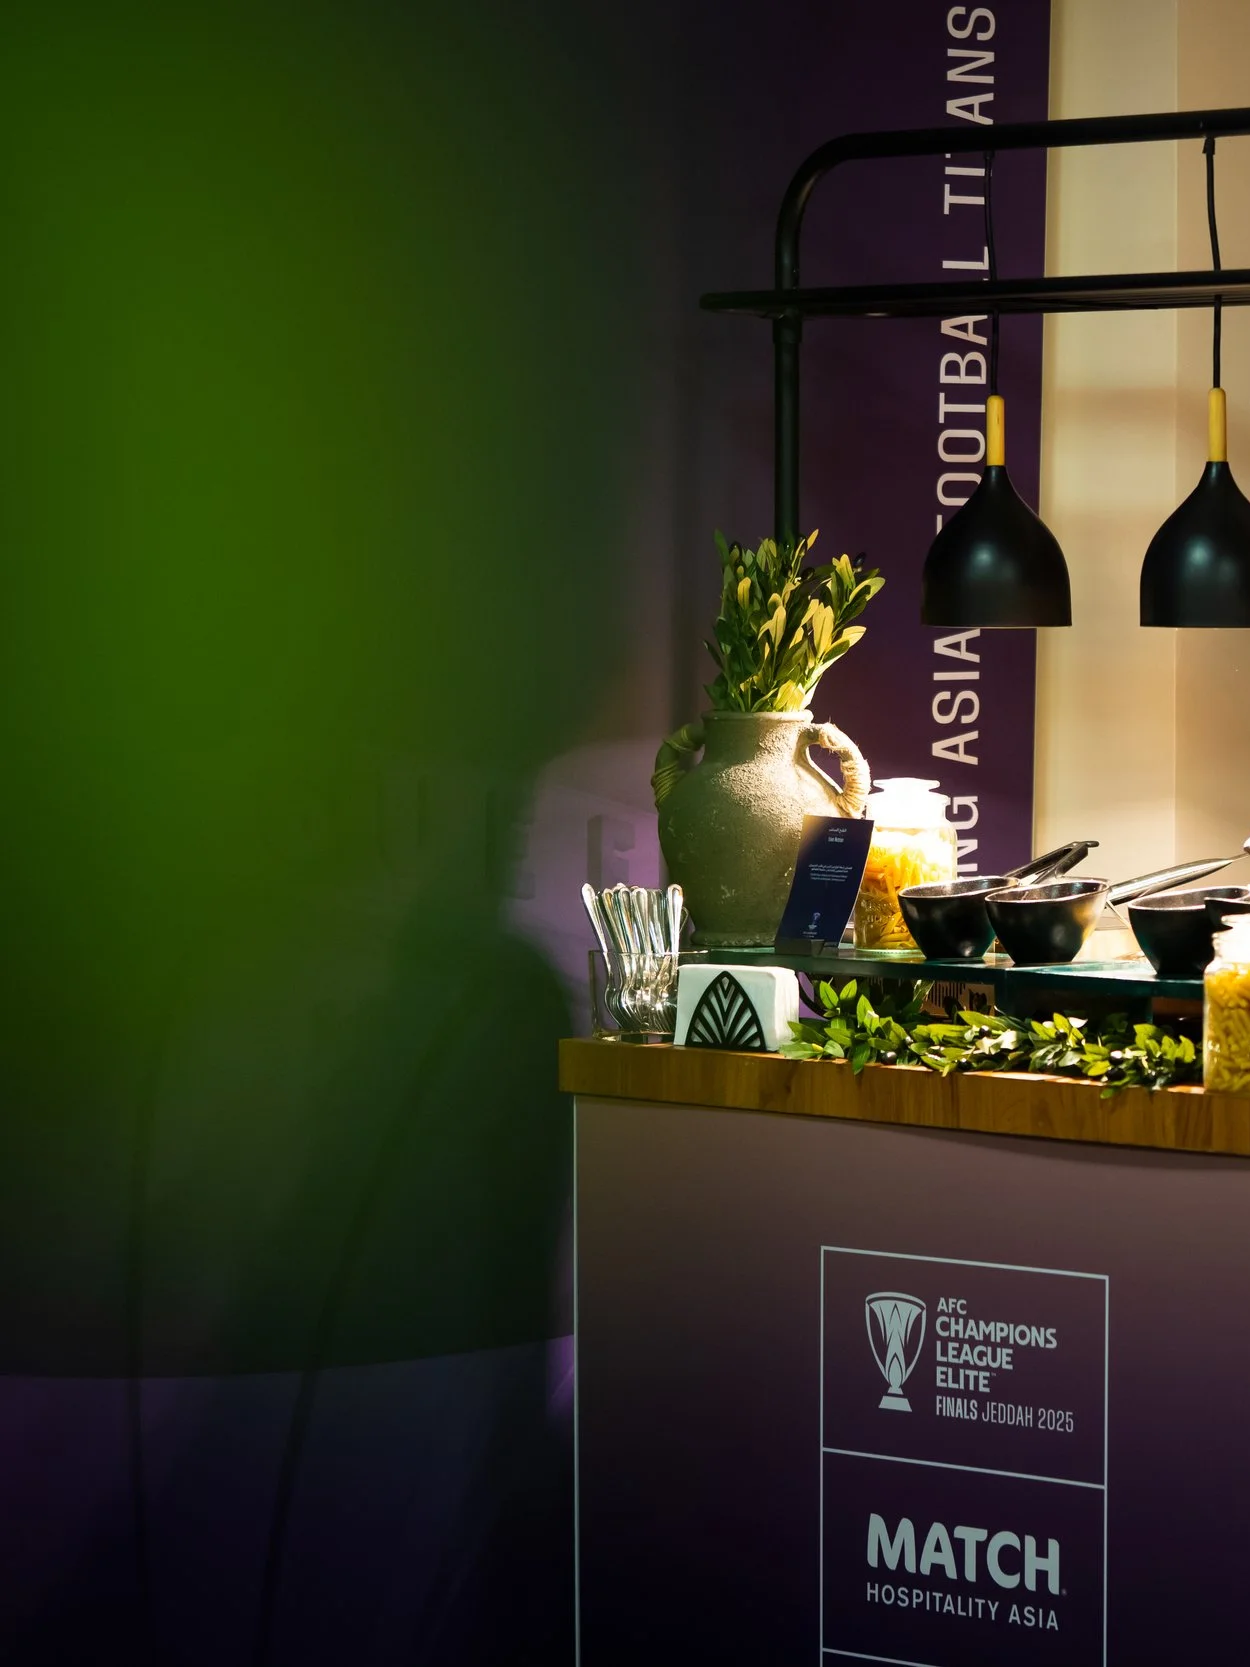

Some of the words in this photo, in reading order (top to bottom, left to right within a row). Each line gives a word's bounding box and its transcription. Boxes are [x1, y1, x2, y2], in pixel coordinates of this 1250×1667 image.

[943, 6, 996, 215] TIANS
[936, 246, 989, 536] OOTBAL
[931, 628, 981, 766] ASIA
[936, 1297, 967, 1316] AFC
[935, 1315, 1058, 1350] CHAMPIONS
[936, 1340, 1014, 1371] LEAGUE
[936, 1366, 991, 1393] ELITE
[936, 1395, 978, 1421] FINALS
[981, 1401, 1033, 1428] JEDDAH
[1037, 1408, 1075, 1433] 2025
[866, 1512, 1061, 1597] MATCH
[866, 1581, 1000, 1621] HOSPITALITY
[1008, 1604, 1060, 1631] ASIA
